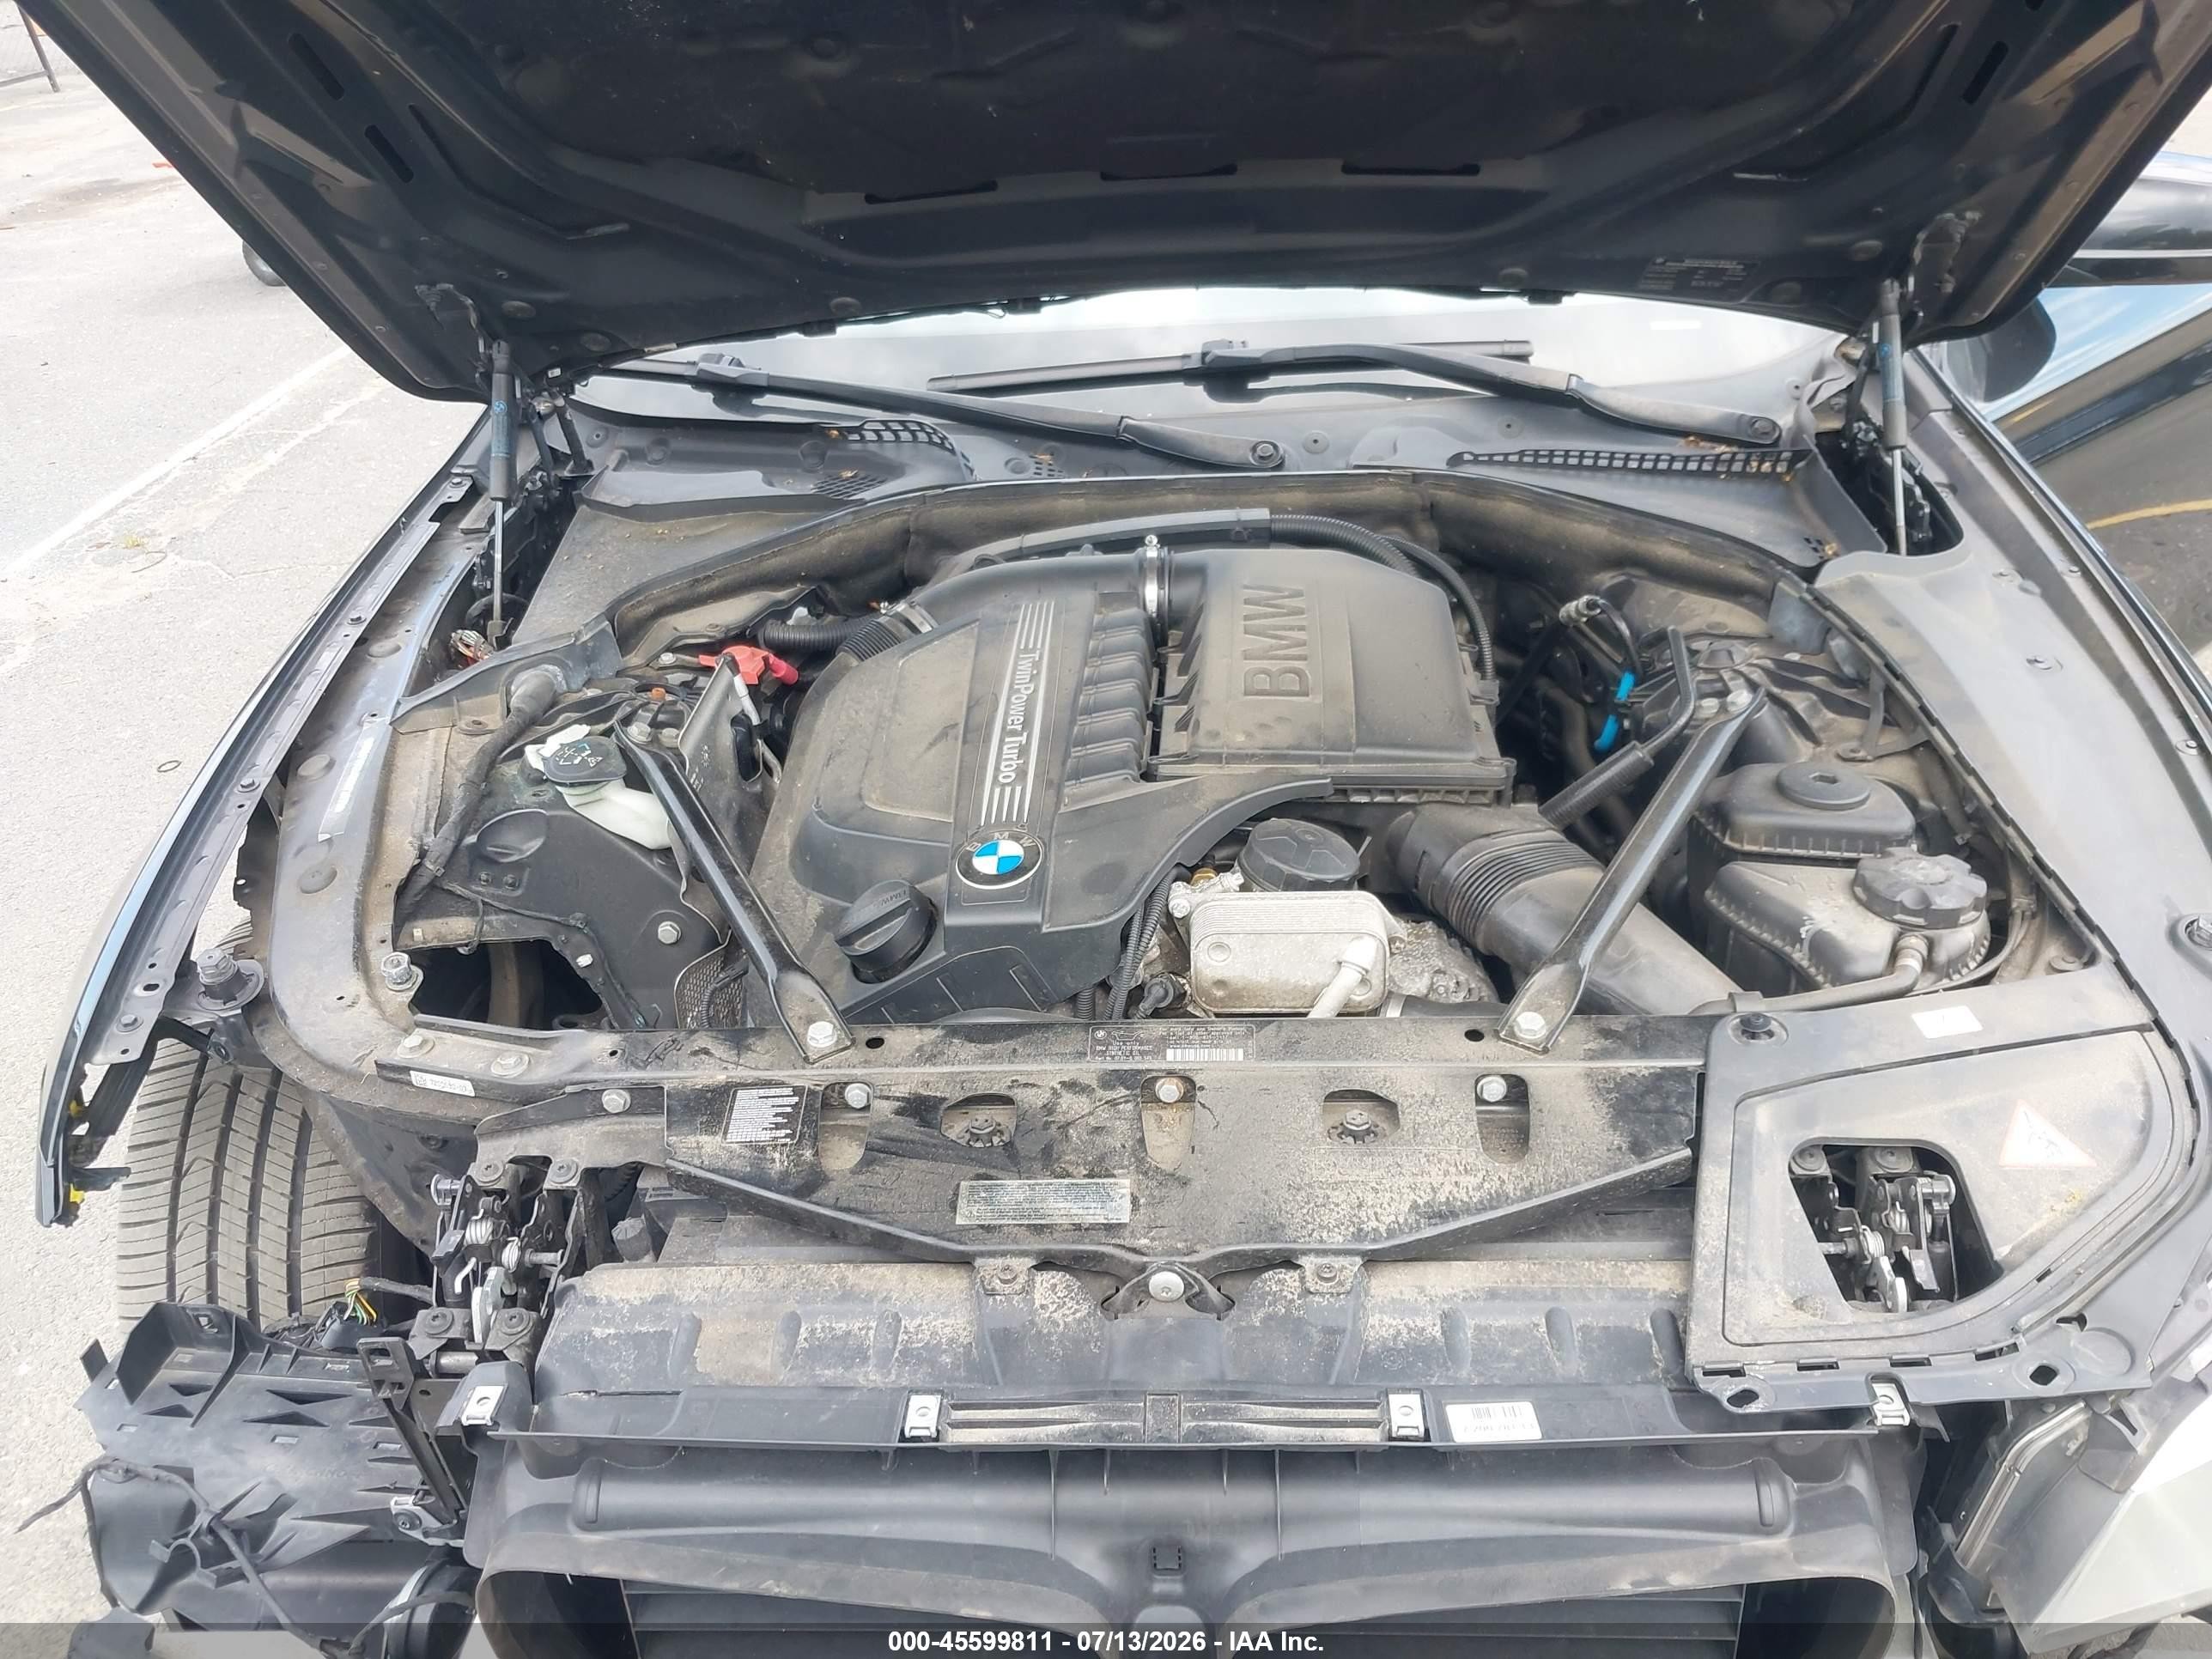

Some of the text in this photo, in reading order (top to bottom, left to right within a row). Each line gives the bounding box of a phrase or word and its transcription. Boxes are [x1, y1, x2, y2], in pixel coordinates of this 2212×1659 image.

[1242, 584, 1310, 697] BMW
[998, 650, 1040, 783] TwinPower Turbo
[966, 832, 1036, 853] BMW
